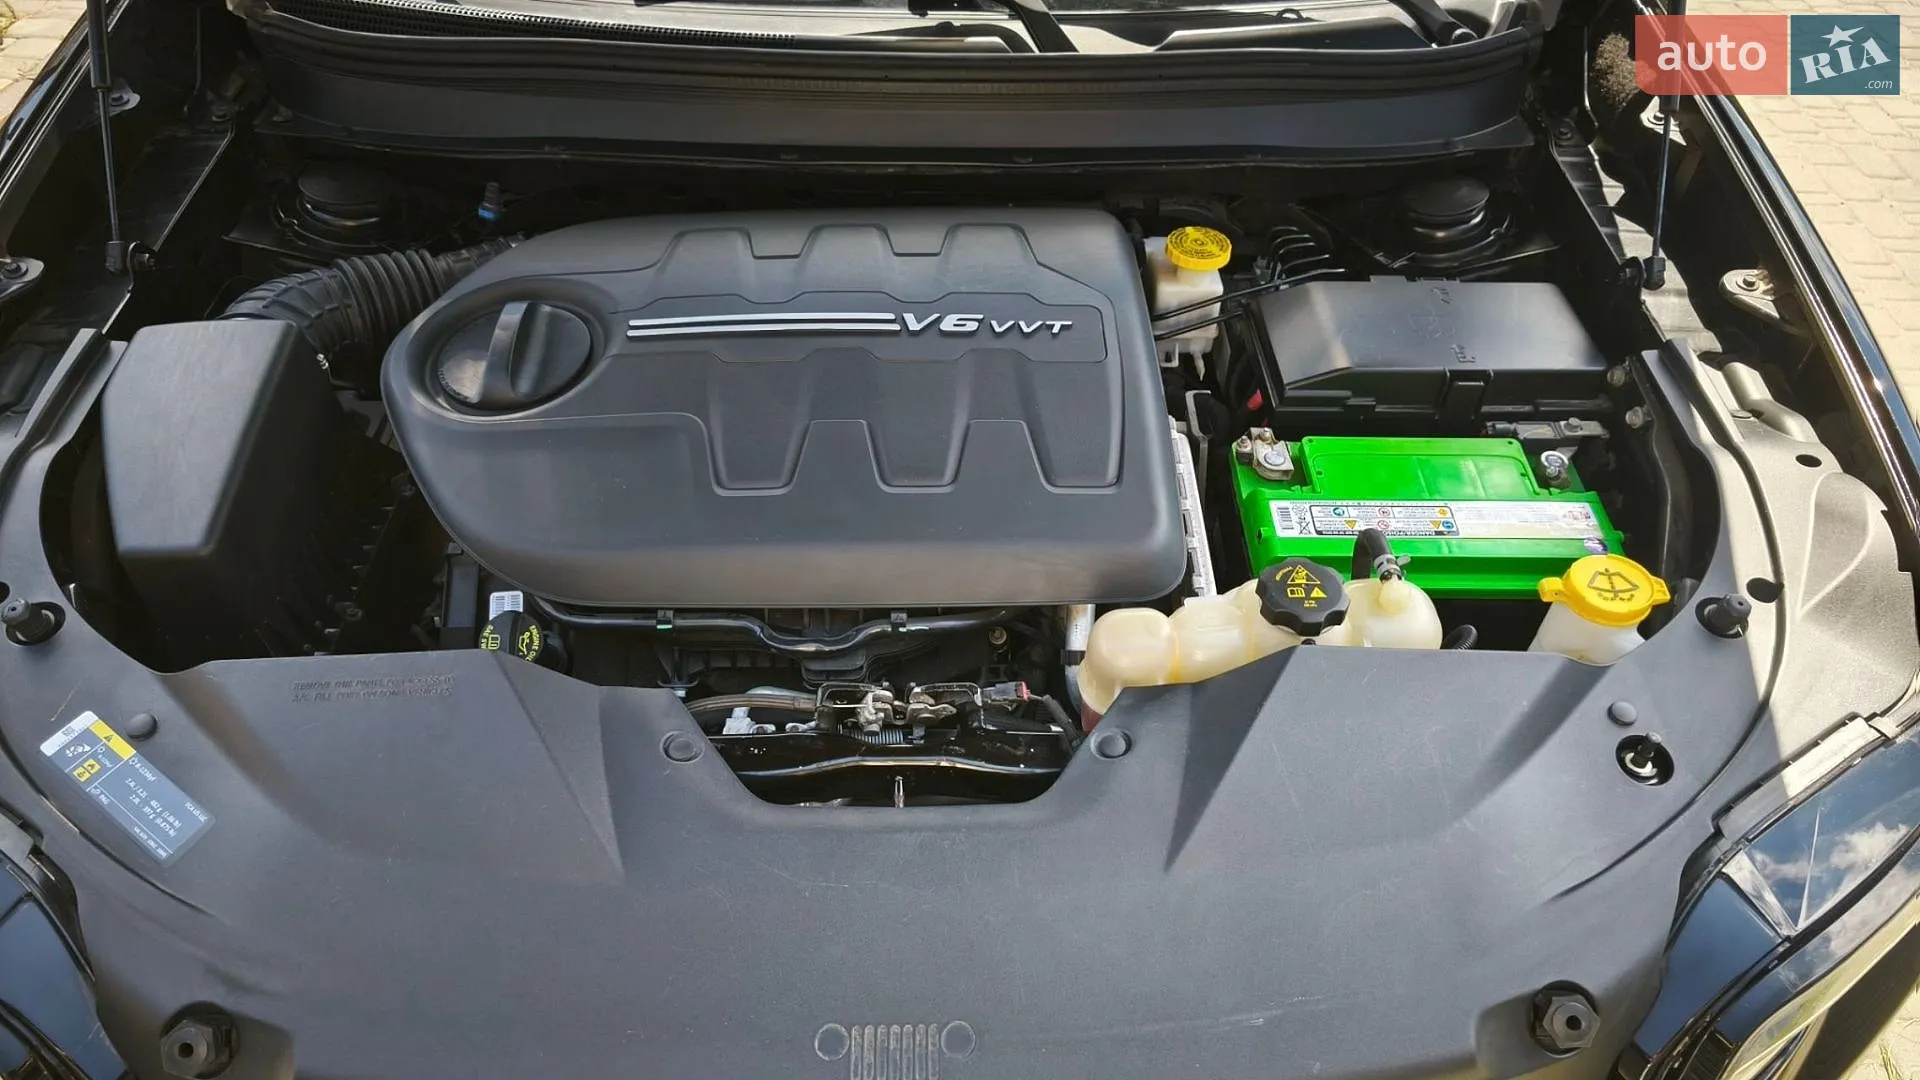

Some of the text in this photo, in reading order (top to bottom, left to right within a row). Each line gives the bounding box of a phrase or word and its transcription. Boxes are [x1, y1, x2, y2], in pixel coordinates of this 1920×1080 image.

[902, 312, 1073, 334] V6 VVT
[529, 625, 540, 651] ENGINE
